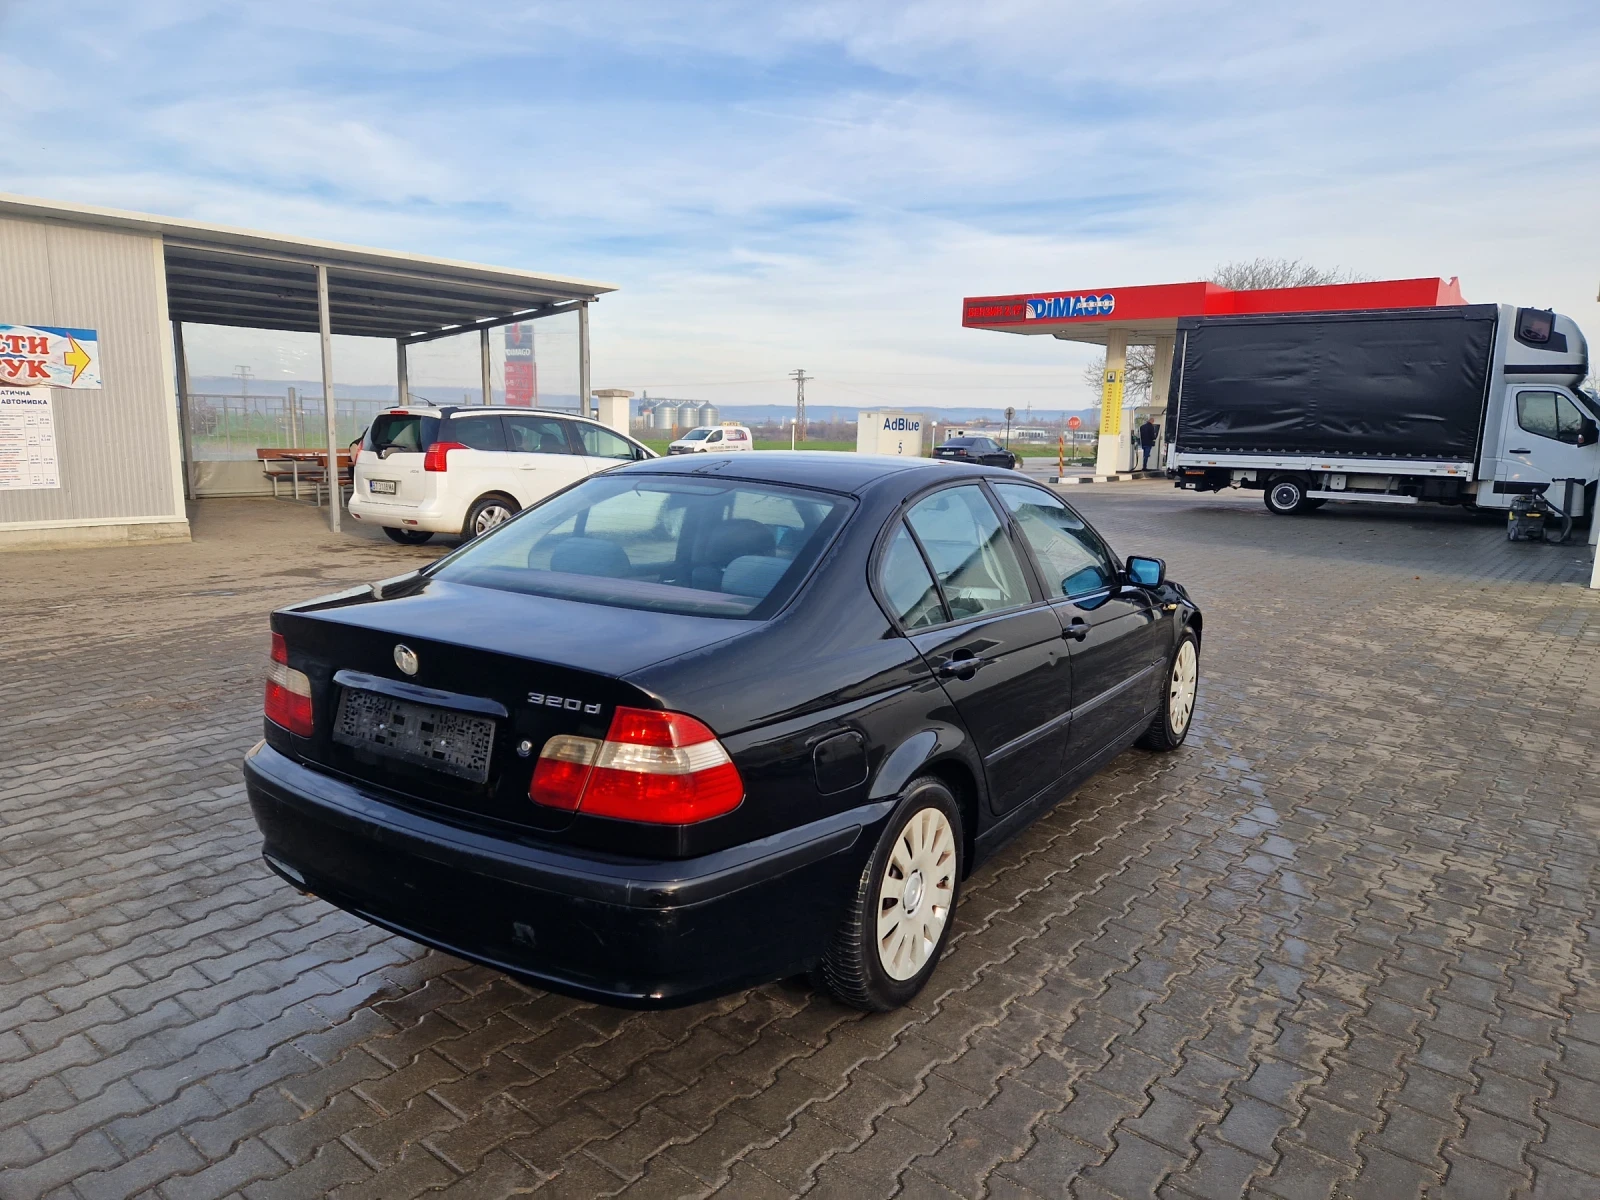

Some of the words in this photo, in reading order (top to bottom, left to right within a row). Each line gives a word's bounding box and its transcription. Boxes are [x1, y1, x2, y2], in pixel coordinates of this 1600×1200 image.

[968, 305, 1003, 317] БЕНЗИН
[0, 334, 50, 354] ТИ
[0, 359, 51, 378] УК
[883, 417, 920, 431] AdBlue
[897, 441, 903, 454] 5
[527, 691, 602, 714] 320d
